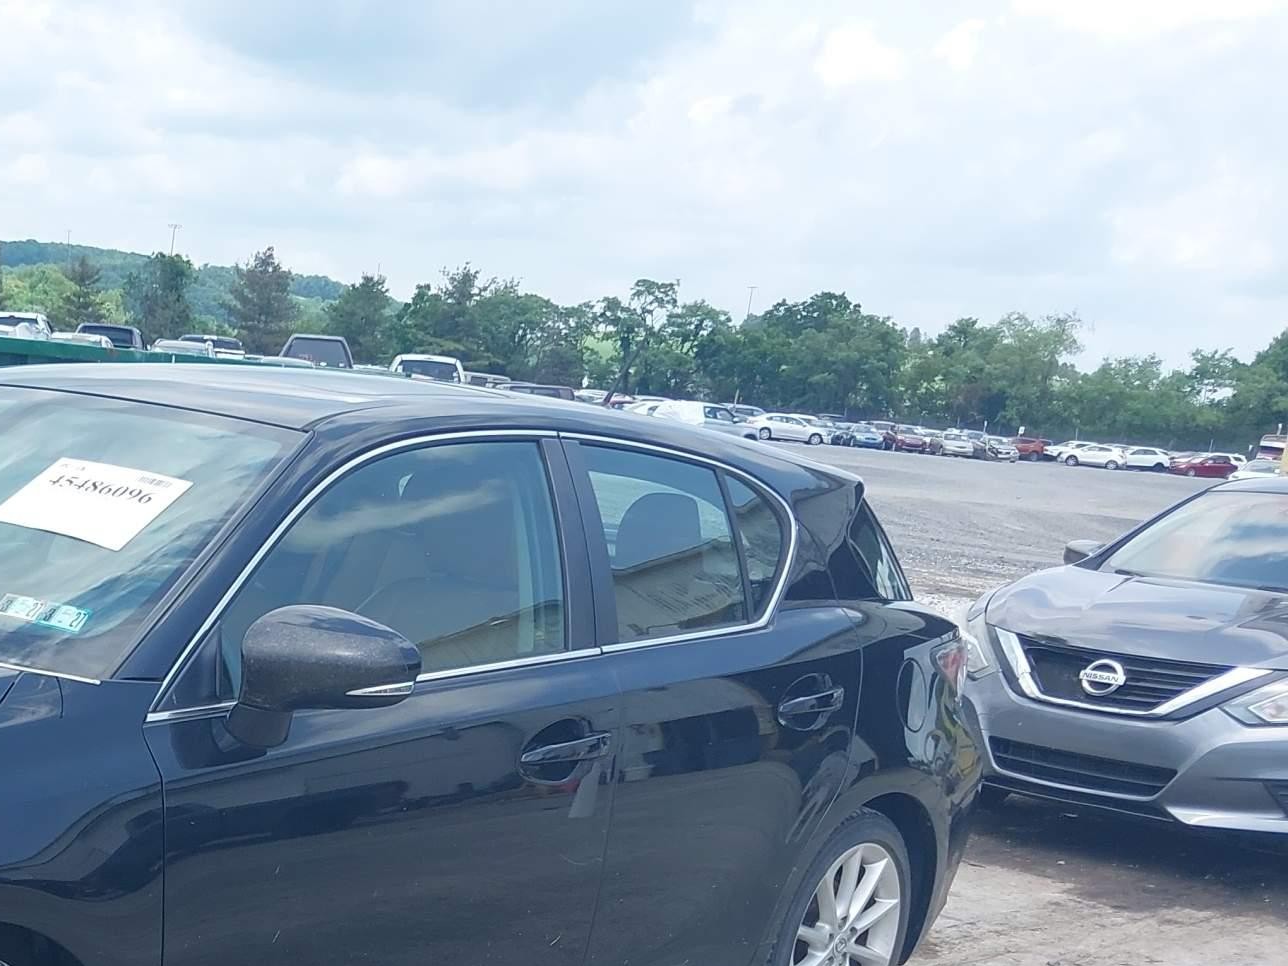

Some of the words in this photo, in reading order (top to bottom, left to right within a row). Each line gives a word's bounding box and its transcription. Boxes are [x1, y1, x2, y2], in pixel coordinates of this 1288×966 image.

[49, 474, 154, 505] 45486096
[68, 611, 87, 629] 27
[1083, 671, 1119, 683] NISSAN
